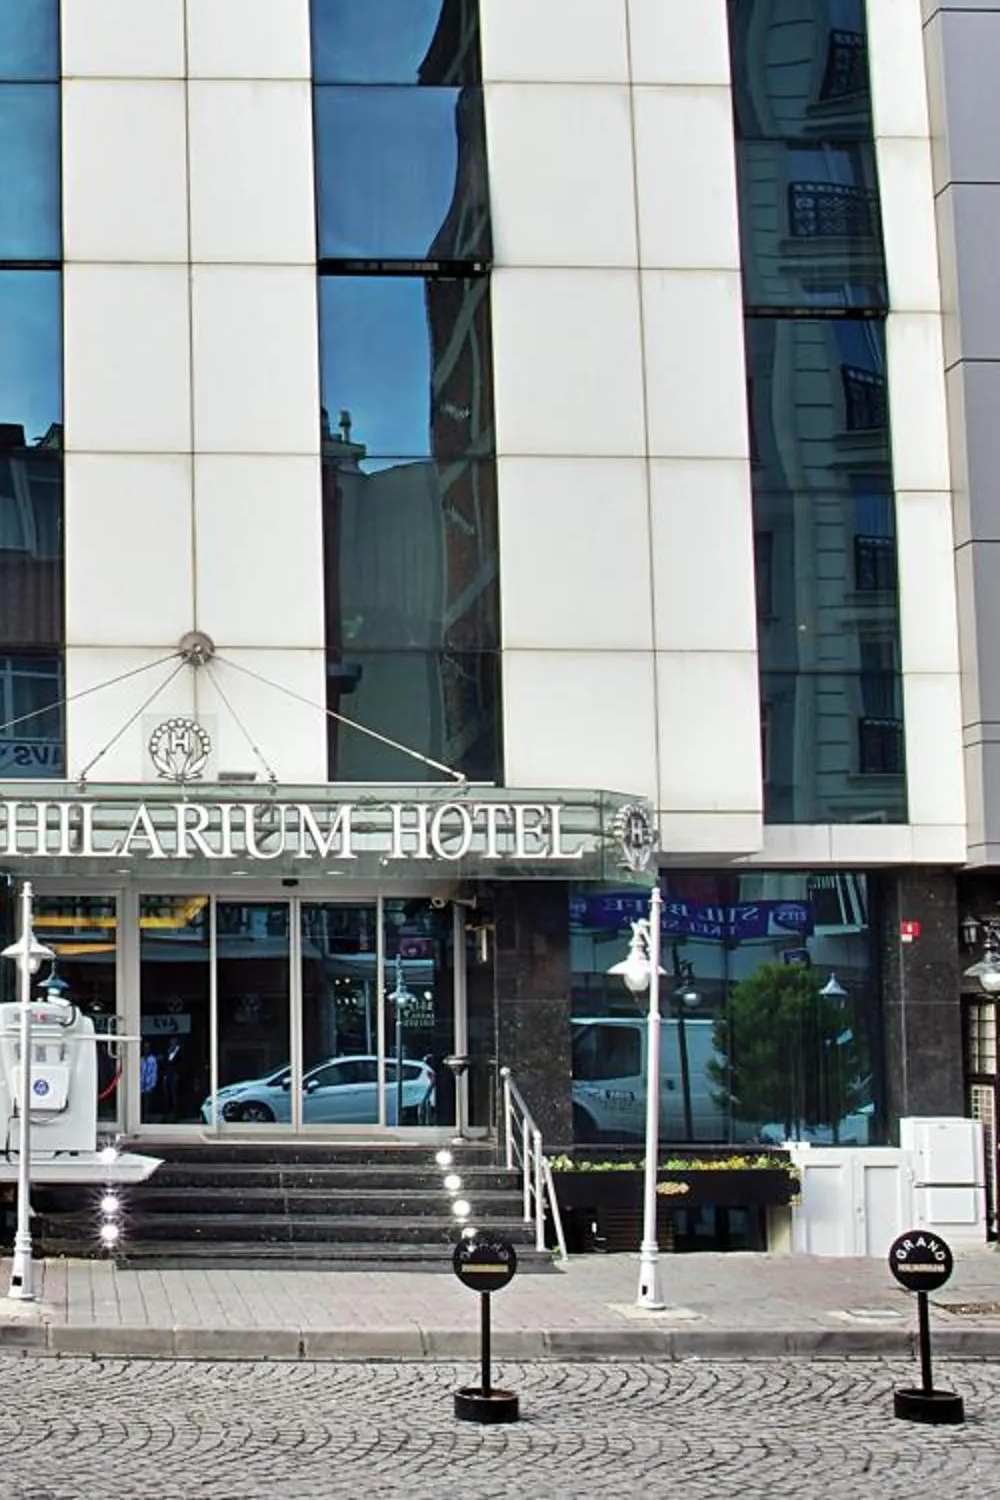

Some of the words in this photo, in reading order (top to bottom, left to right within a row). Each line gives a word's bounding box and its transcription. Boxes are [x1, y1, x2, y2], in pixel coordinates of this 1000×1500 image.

[1, 801, 358, 860] HILARIUM
[391, 803, 584, 860] HOTEL
[895, 1236, 946, 1261] GRAND
